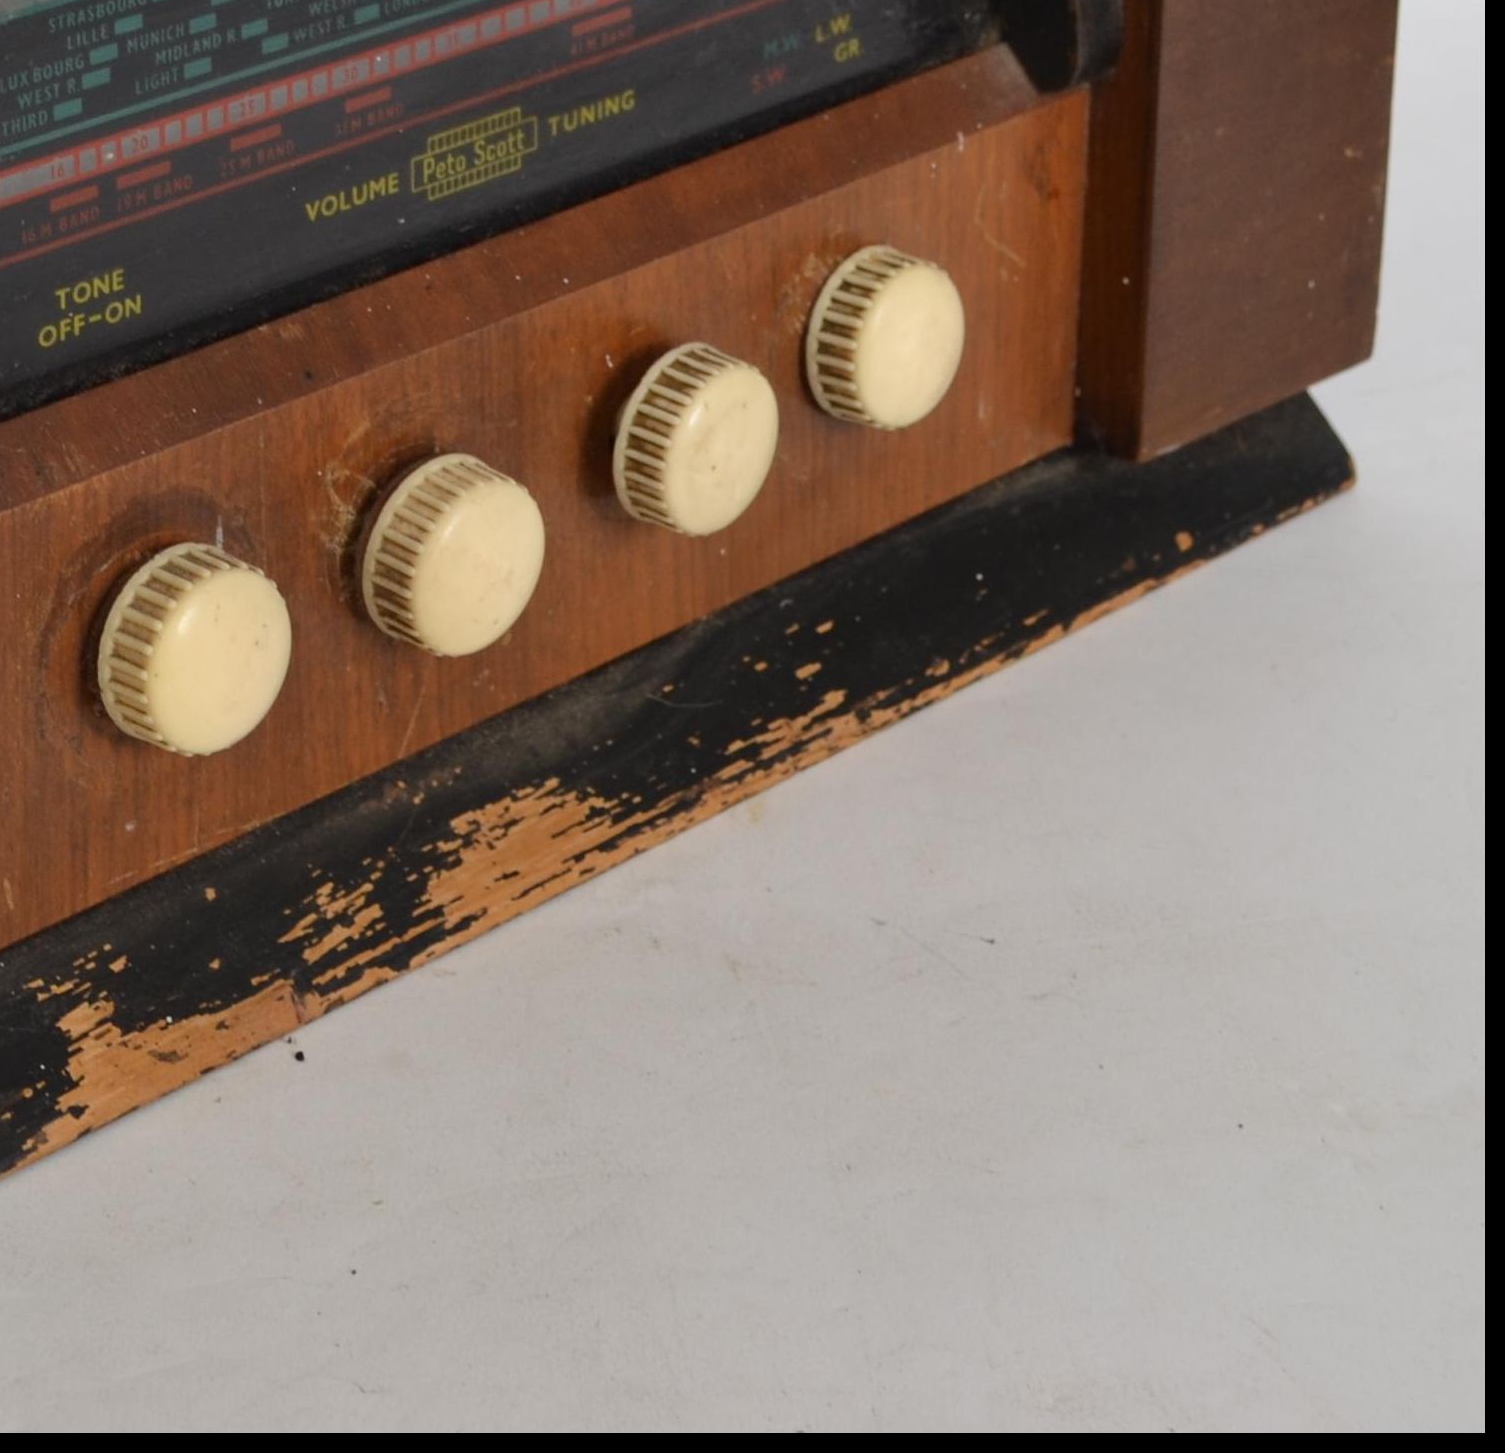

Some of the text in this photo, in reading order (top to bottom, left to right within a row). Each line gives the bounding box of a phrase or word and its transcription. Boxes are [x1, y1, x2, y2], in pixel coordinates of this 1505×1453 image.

[66, 22, 108, 50] LILLE
[125, 20, 185, 55] MUNICH
[291, 17, 332, 45] WEST
[155, 31, 222, 67] MIDLAND
[134, 65, 179, 95] LIGHT
[17, 81, 60, 111] WEST
[237, 96, 256, 119] 25
[0, 107, 48, 138] THIRD
[548, 90, 637, 137] TUNING
[130, 131, 149, 154] 20
[256, 137, 295, 166] BAND
[422, 128, 526, 184] Peto Scott
[48, 159, 65, 181] 16
[152, 172, 193, 201] BAND
[305, 173, 399, 222] VOLUME
[58, 203, 100, 234] BAND
[55, 268, 124, 310] TONE
[38, 294, 142, 347] OFF-ON
